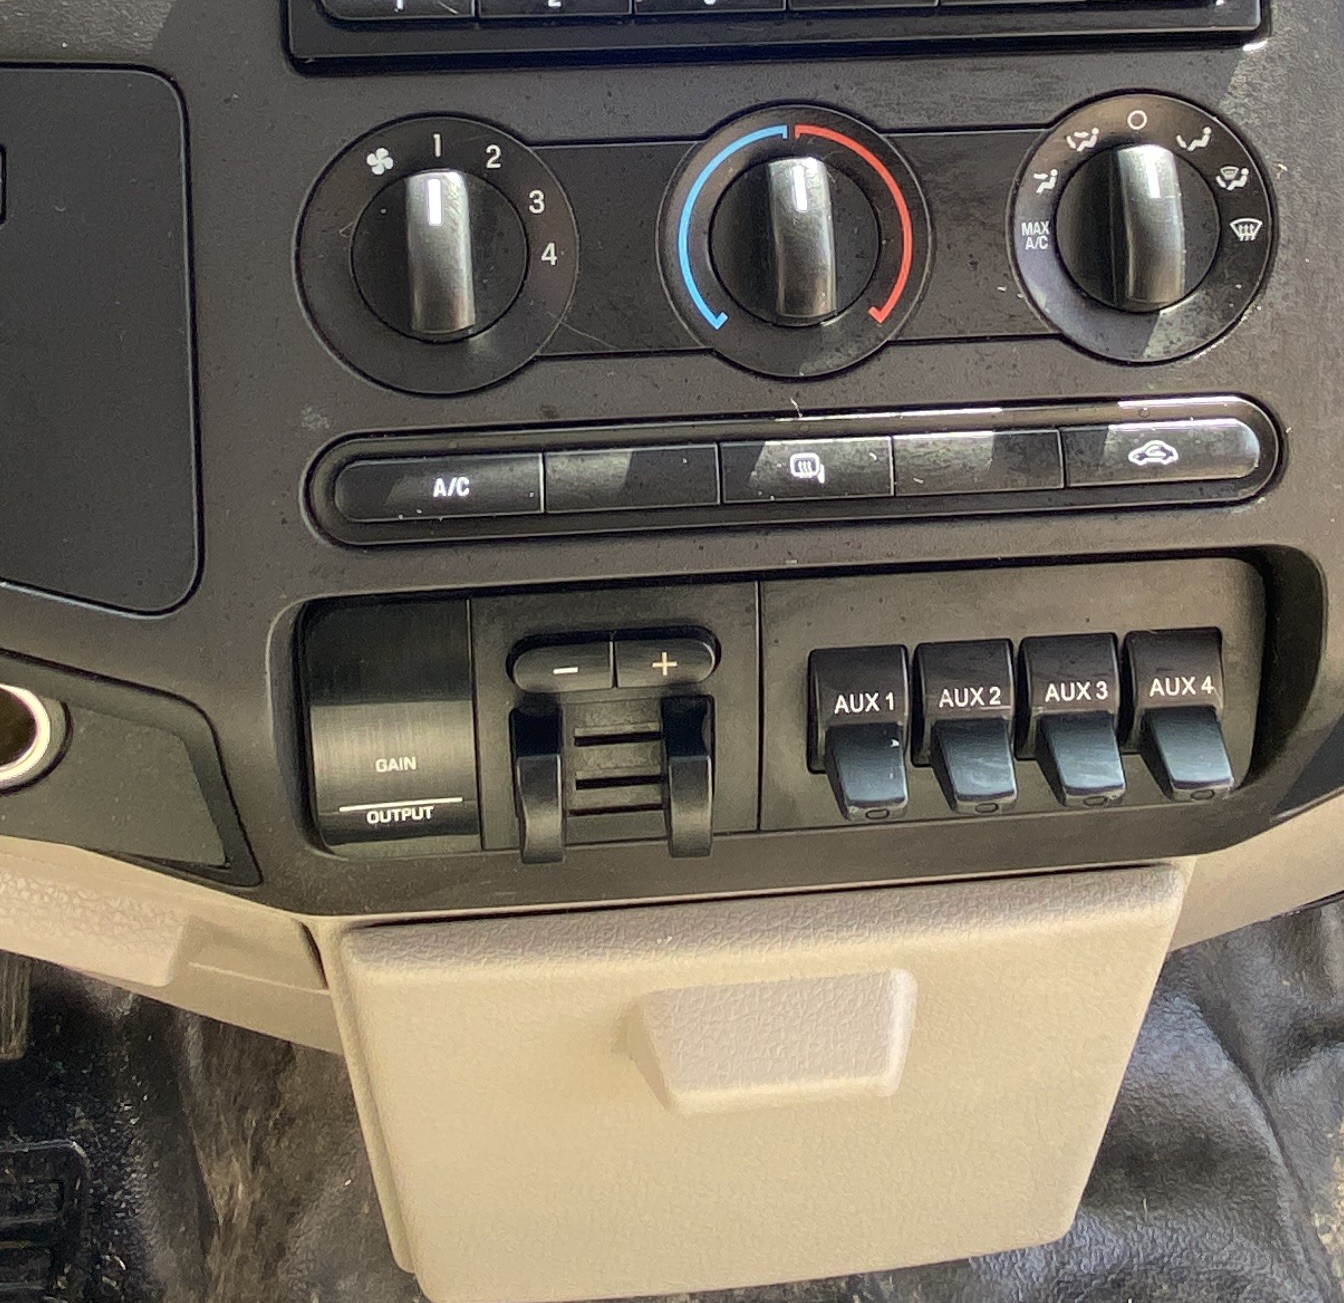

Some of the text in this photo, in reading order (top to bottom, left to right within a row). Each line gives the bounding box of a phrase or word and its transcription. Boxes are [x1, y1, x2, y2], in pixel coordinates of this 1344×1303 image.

[433, 133, 442, 157] 1
[485, 145, 502, 169] 2
[528, 190, 546, 215] 3
[1021, 221, 1051, 237] MAX
[541, 243, 558, 267] 4
[1025, 237, 1050, 250] A/C
[433, 476, 470, 498] A/C
[939, 687, 1001, 709] AUX 2
[1045, 680, 1108, 704] AUX 3
[1149, 675, 1213, 699] AUX 4
[834, 692, 895, 715] AUX 1
[375, 756, 417, 773] GAIN
[366, 805, 434, 825] OUTPUT
